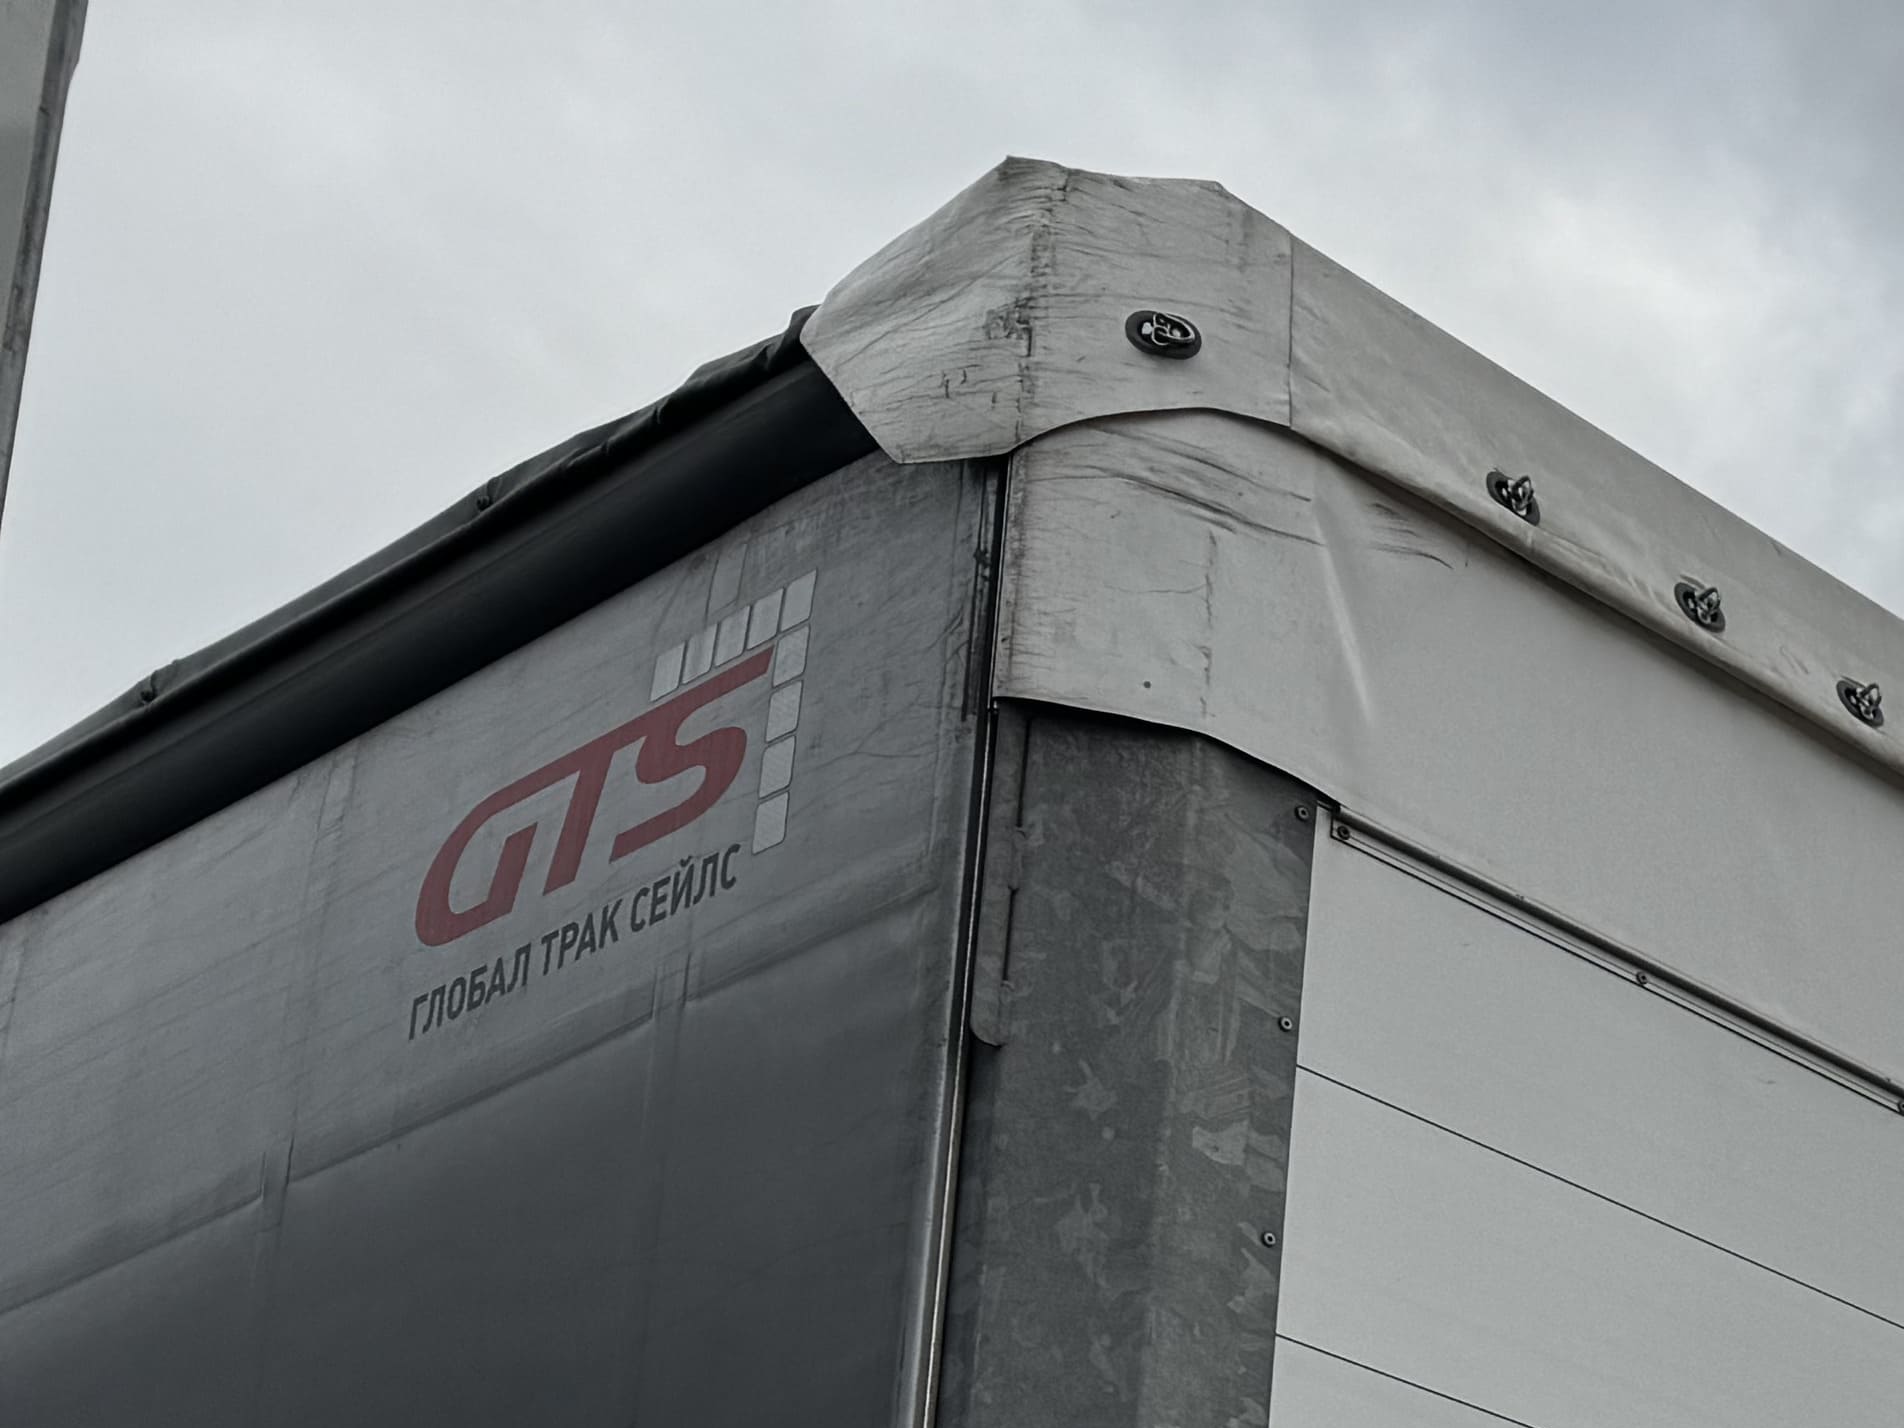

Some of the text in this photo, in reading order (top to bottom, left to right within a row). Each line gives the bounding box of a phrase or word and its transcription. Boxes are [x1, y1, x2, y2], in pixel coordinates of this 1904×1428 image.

[415, 647, 774, 946] GTS
[407, 843, 742, 1041] ГЛОБАЛ ТРАК СЕЙЛС
